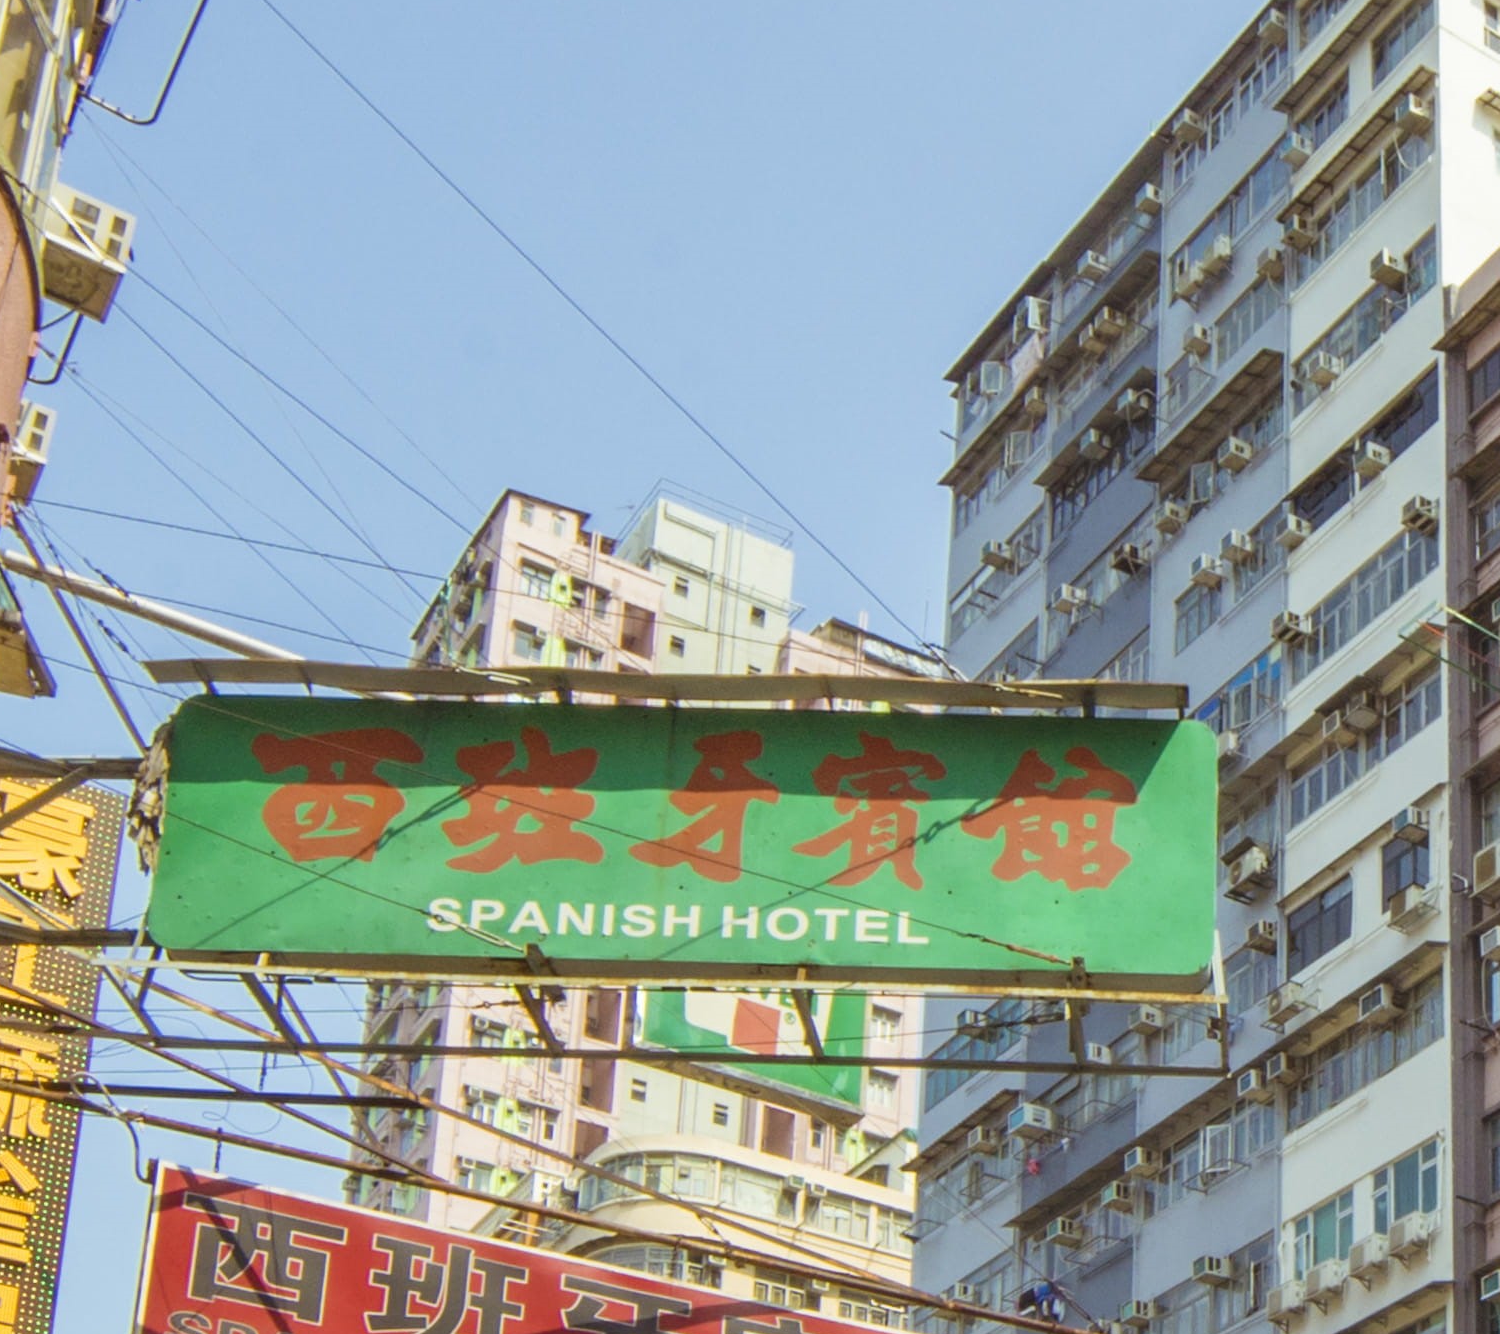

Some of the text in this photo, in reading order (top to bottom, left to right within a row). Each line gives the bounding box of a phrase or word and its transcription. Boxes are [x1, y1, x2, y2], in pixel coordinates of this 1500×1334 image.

[250, 726, 1139, 893] 西班牙賓館
[426, 896, 931, 947] SPANISH HOTEL
